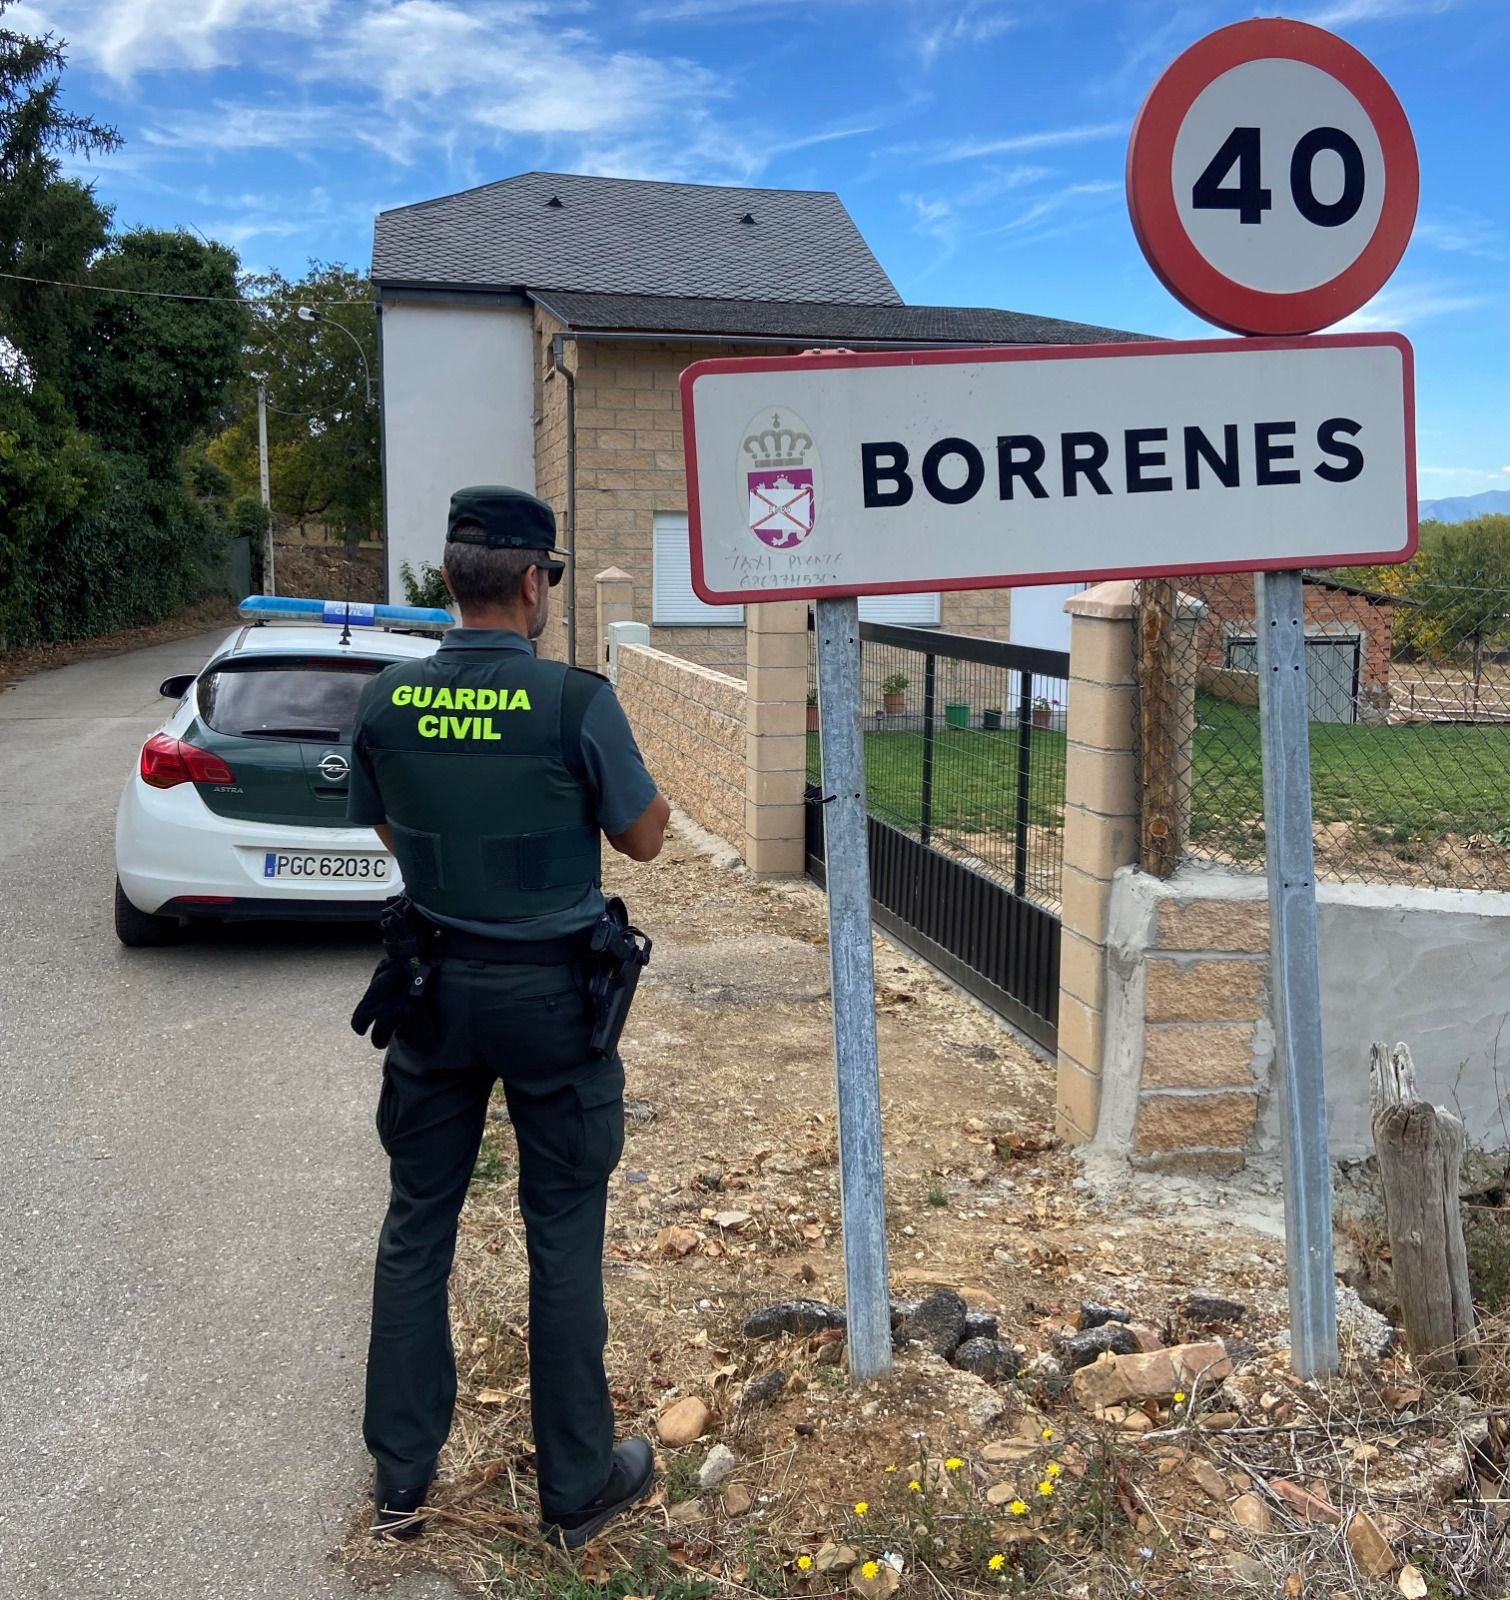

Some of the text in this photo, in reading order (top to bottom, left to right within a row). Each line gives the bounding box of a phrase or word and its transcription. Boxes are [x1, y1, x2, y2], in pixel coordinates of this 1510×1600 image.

[1192, 126, 1365, 228] 40
[861, 417, 1364, 508] BORRENES
[391, 685, 532, 710] GUARDIA
[417, 715, 502, 740] CIVIL
[213, 786, 244, 794] ASTRA
